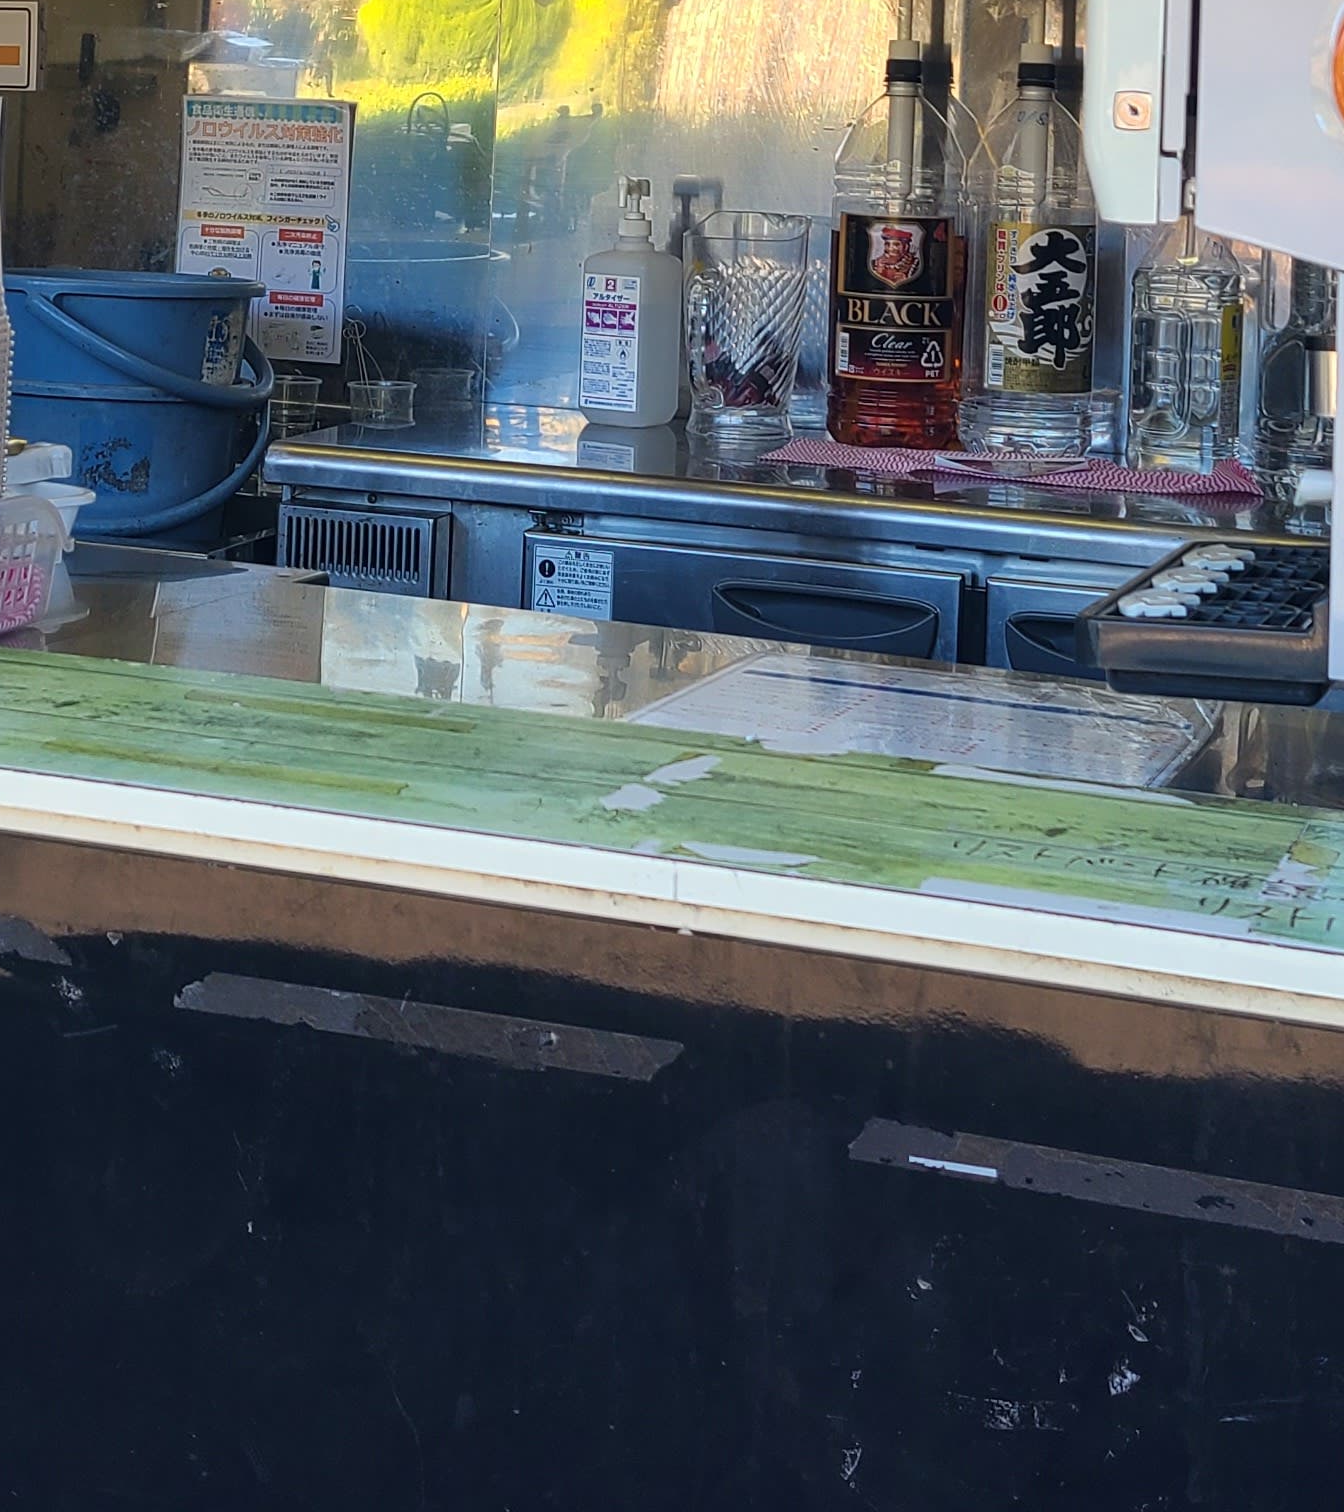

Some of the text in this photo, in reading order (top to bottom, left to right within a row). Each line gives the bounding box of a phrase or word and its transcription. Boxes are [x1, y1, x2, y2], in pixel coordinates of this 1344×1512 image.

[847, 297, 943, 327] BLACK
[1010, 230, 1087, 370] 大五郎
[871, 332, 913, 350] Clear
[924, 369, 940, 378] PET
